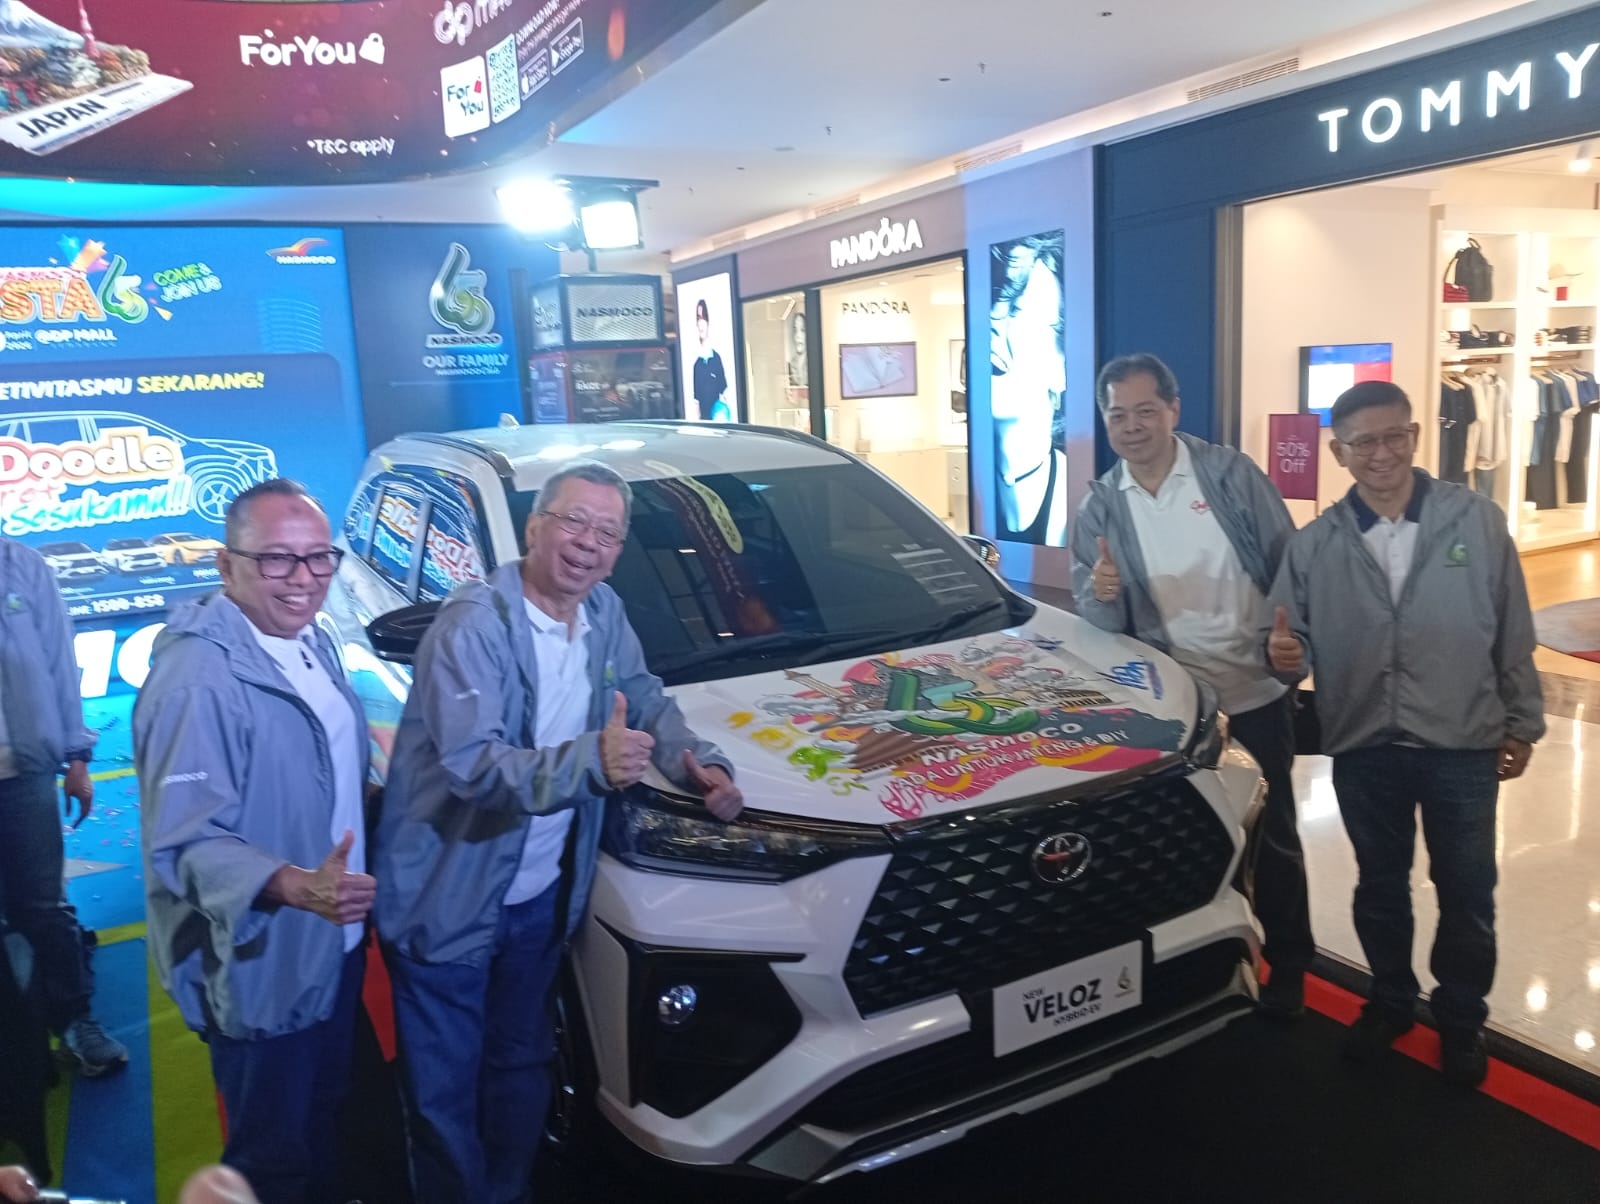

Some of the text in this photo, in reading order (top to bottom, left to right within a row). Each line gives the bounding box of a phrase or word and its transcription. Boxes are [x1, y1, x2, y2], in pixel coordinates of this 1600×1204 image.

[446, 84, 471, 102] For
[1318, 43, 1600, 152] TOMMY
[460, 100, 484, 117] You
[17, 99, 108, 138] JAPAN
[349, 136, 395, 157] apply
[0, 277, 105, 323] STA
[841, 298, 911, 315] PANDORA
[576, 306, 653, 317] NASMOCO
[430, 335, 500, 345] NASMOCO
[422, 353, 509, 369] OUR FAMILY
[136, 371, 265, 394] SEKARANG!
[1276, 441, 1311, 457] 50%
[1279, 458, 1307, 474] Off
[920, 722, 1083, 767] NASMOCO
[1024, 978, 1102, 1023] VELOZ
